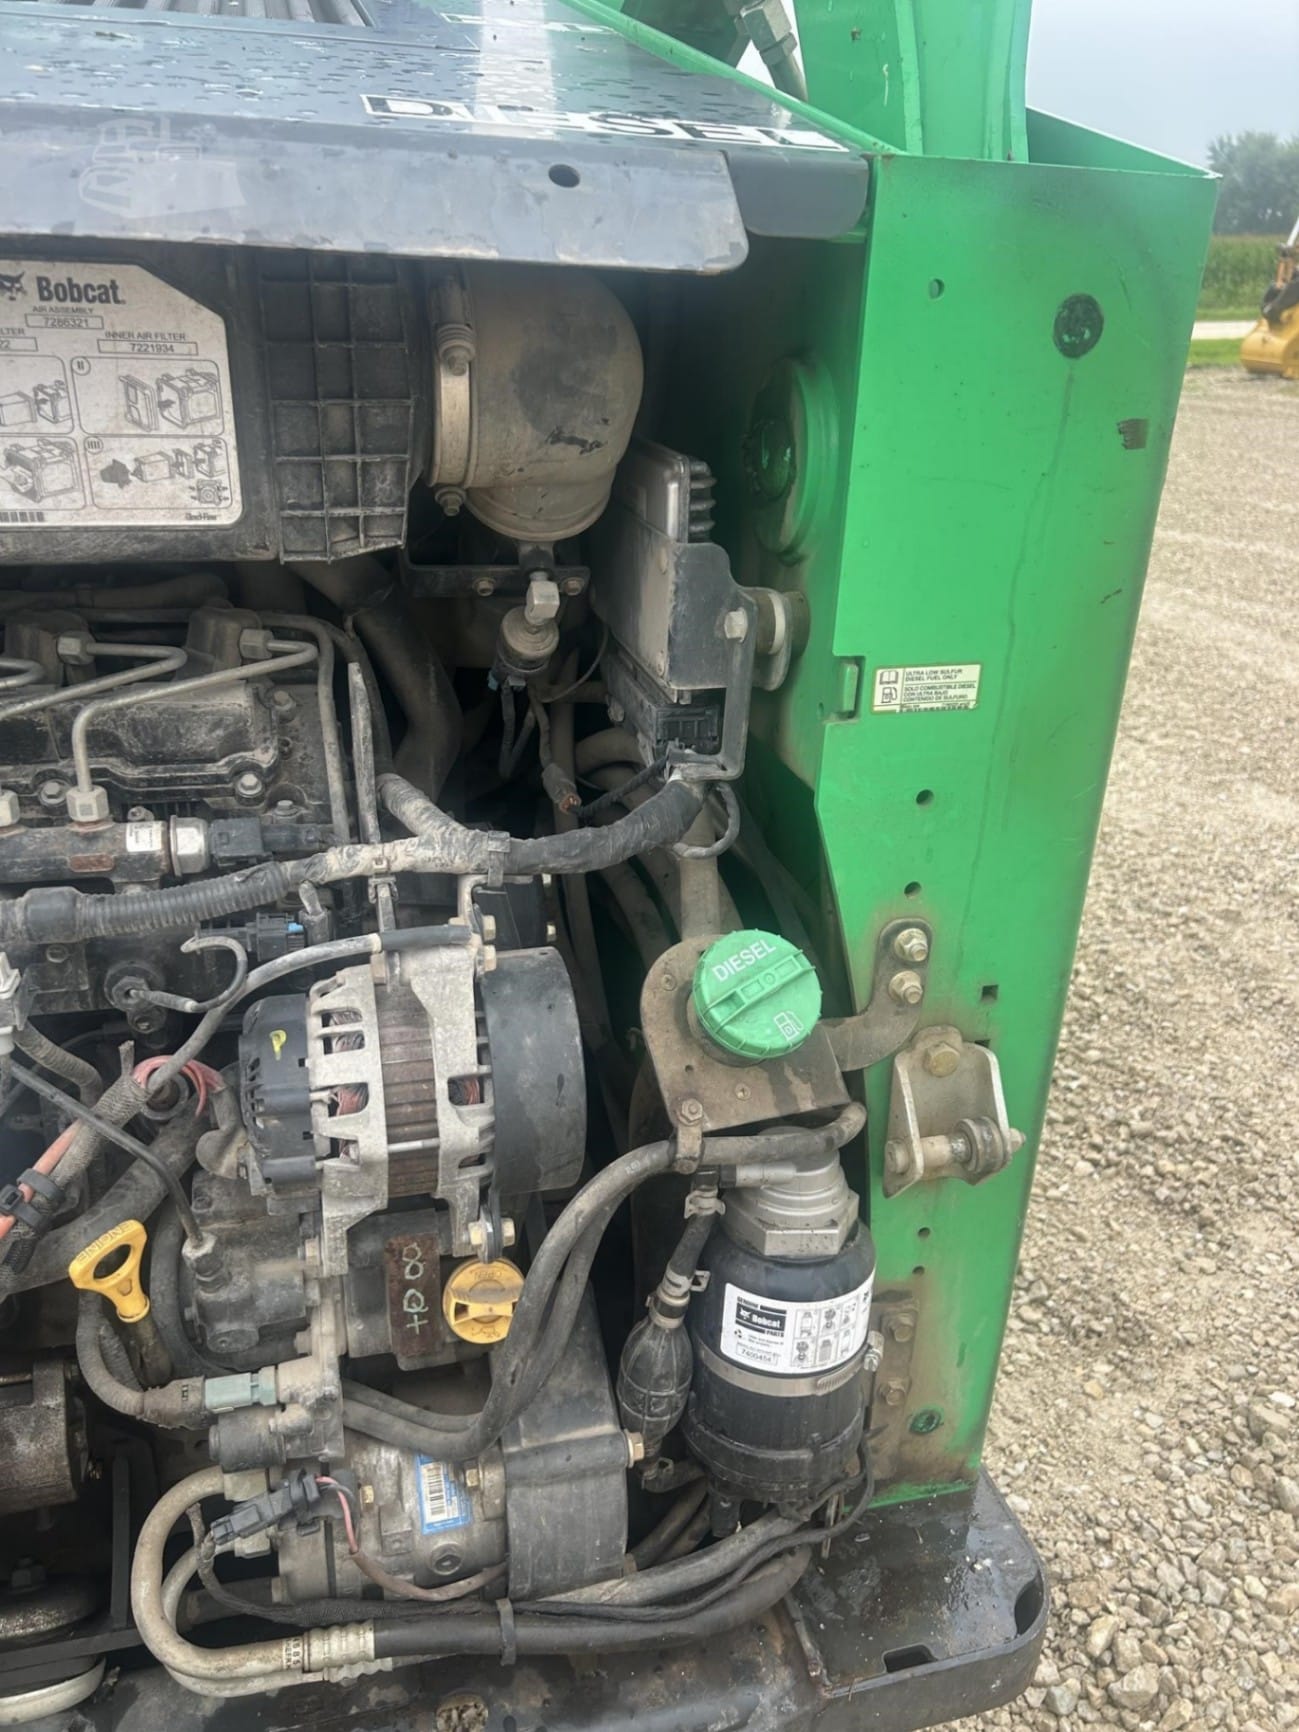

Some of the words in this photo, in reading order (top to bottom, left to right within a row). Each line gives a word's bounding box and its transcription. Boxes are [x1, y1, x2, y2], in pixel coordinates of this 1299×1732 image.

[361, 94, 849, 152] DIESEL
[36, 276, 121, 304] Bobcat
[105, 331, 135, 339] INNER
[136, 332, 152, 340] AIR
[154, 332, 186, 341] FILTER
[712, 939, 776, 981] DIESEL
[77, 1221, 131, 1263] ENGINE
[751, 1314, 781, 1328] Bobcat
